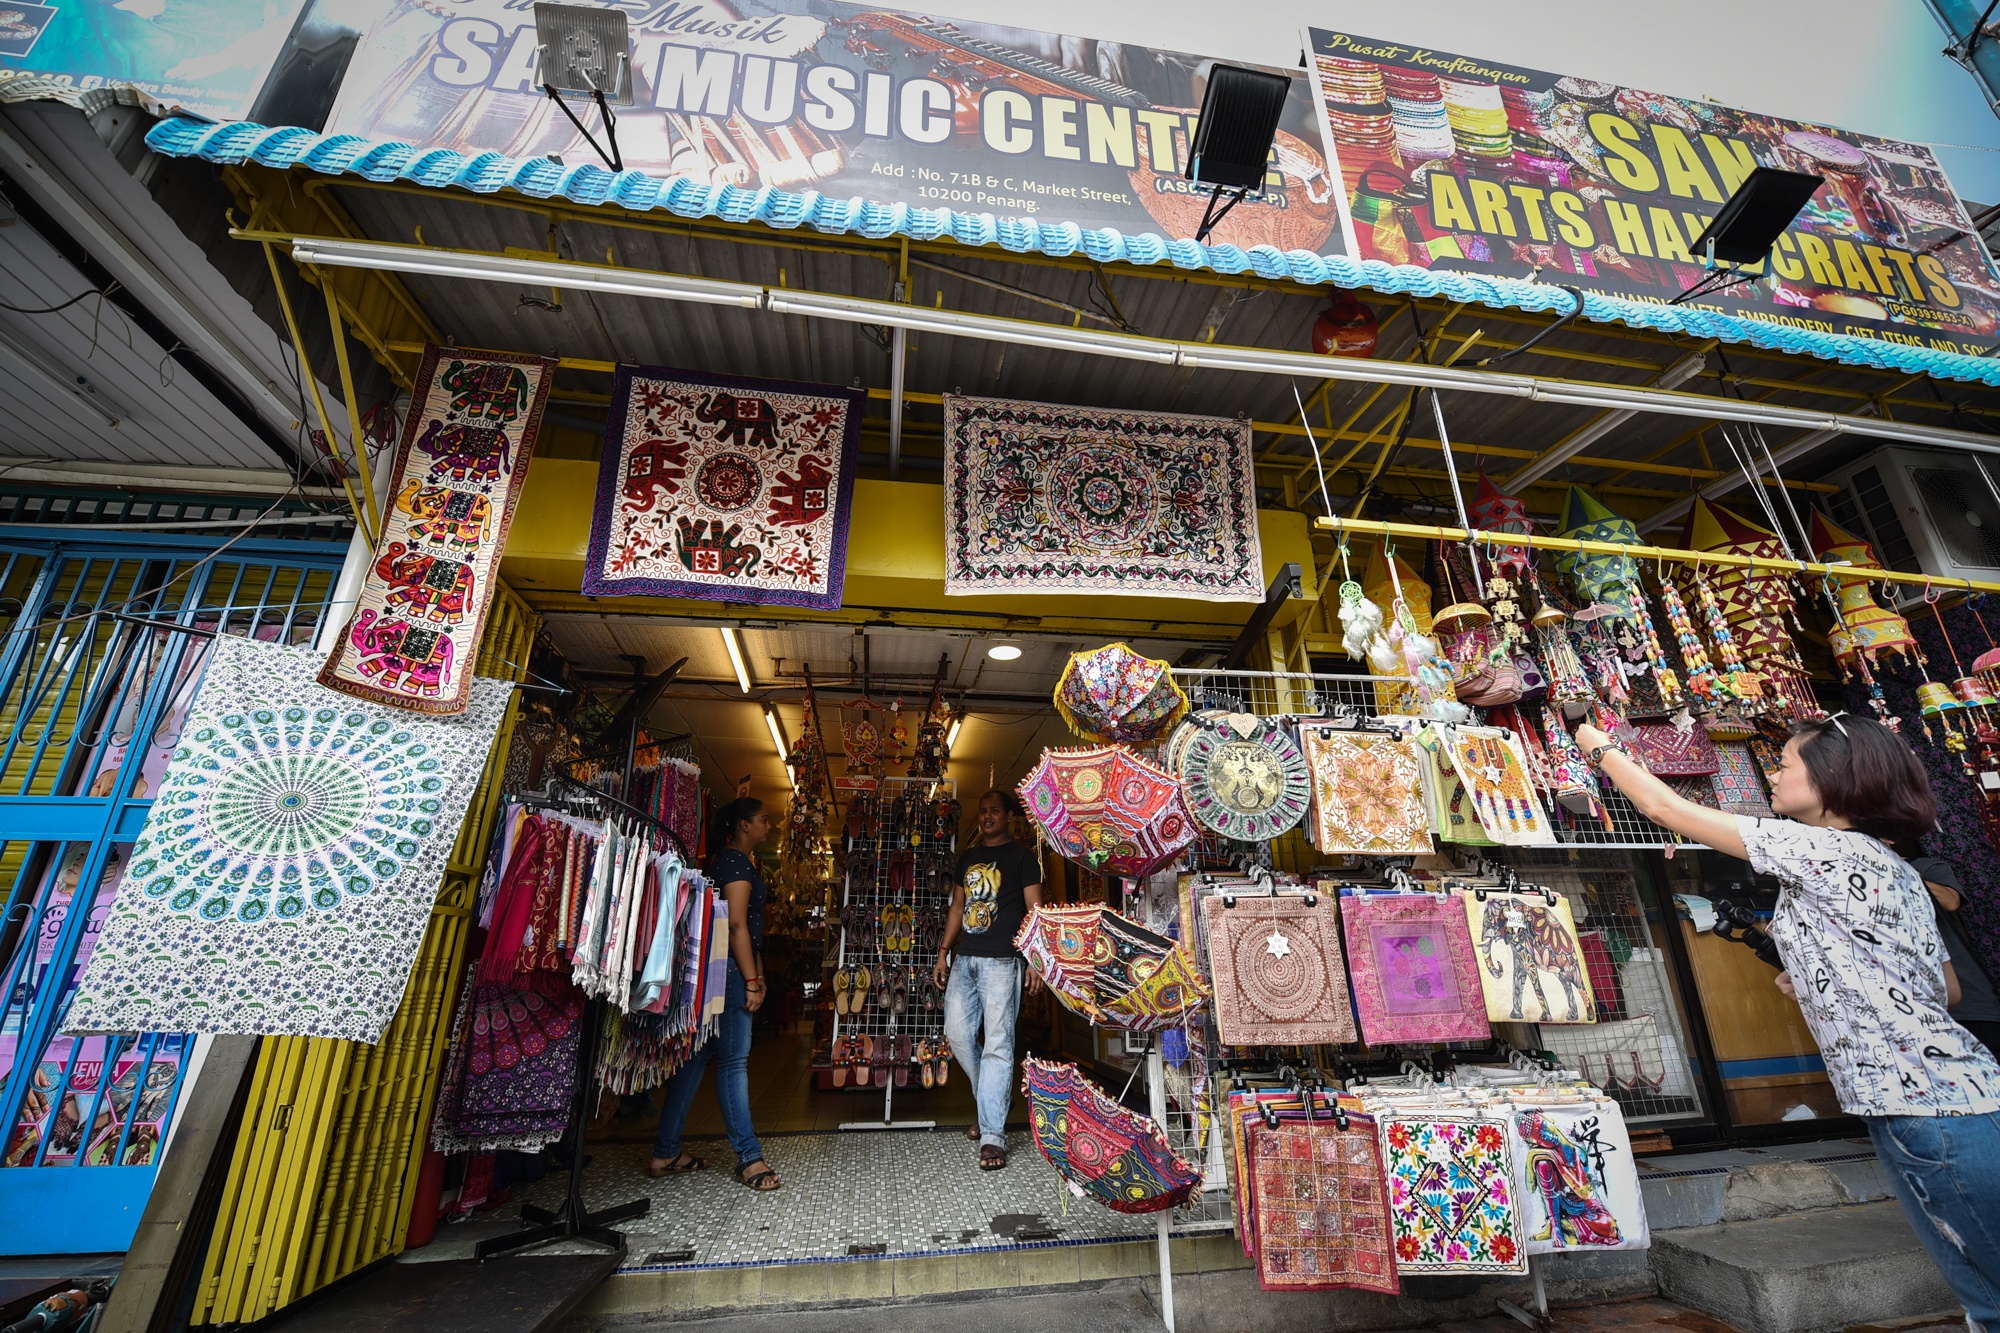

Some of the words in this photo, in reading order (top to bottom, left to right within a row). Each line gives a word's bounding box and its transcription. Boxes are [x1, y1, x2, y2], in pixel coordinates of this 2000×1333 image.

[628, 2, 787, 44] Musik
[1324, 34, 1409, 60] Pusat
[160, 83, 204, 99] Beauty
[655, 43, 955, 145] MUSIC
[871, 162, 904, 177] Add
[918, 167, 945, 183] No.
[949, 172, 981, 187] 71B
[986, 176, 1000, 188] &
[1003, 177, 1019, 193] C,
[1022, 180, 1077, 199] Market
[1080, 186, 1132, 206] Street,
[918, 185, 972, 204] 10200
[976, 191, 1040, 214] Penang.
[1430, 171, 1597, 249] ARTS
